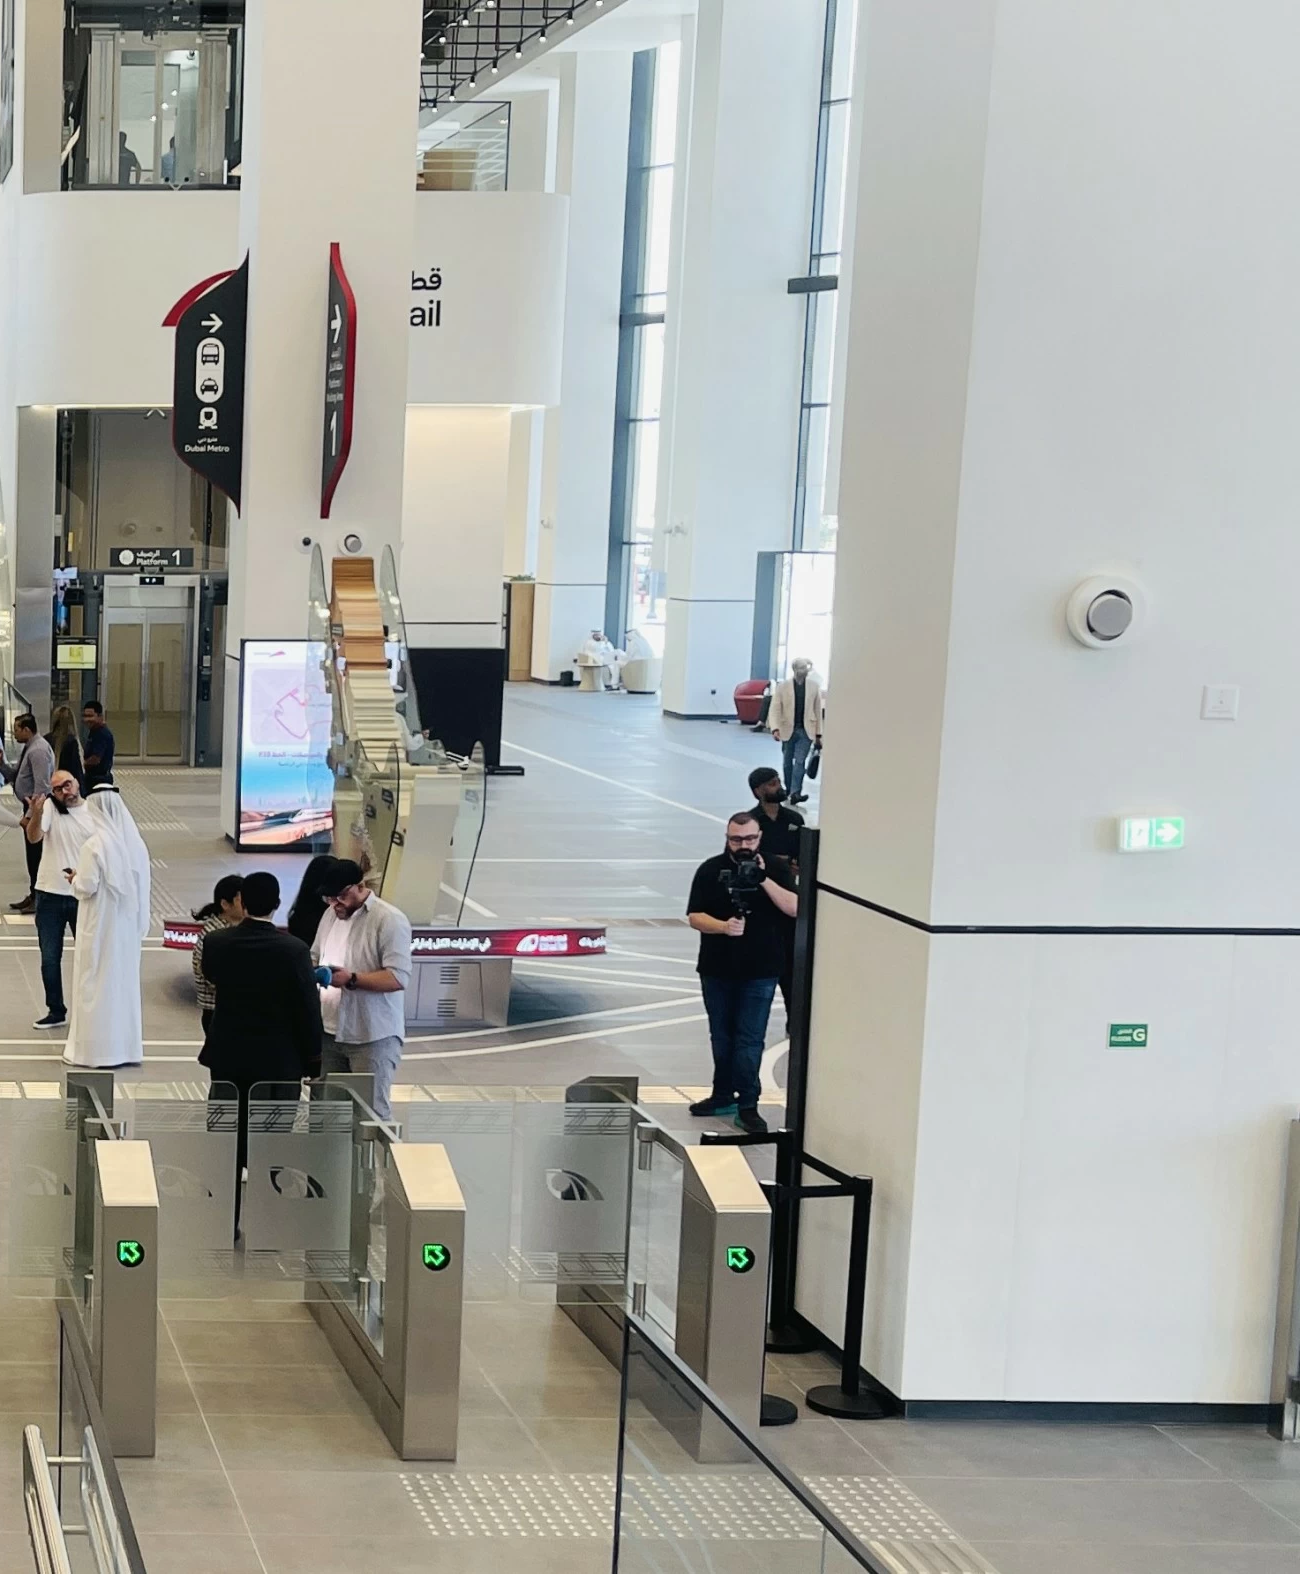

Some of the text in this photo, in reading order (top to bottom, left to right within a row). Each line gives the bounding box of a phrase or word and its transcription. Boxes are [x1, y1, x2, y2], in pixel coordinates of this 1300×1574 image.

[410, 299, 441, 327] ail
[330, 411, 337, 457] 1
[184, 444, 230, 453] Dubai Metro
[136, 549, 180, 566] Platform 1
[1132, 1028, 1146, 1042] G
